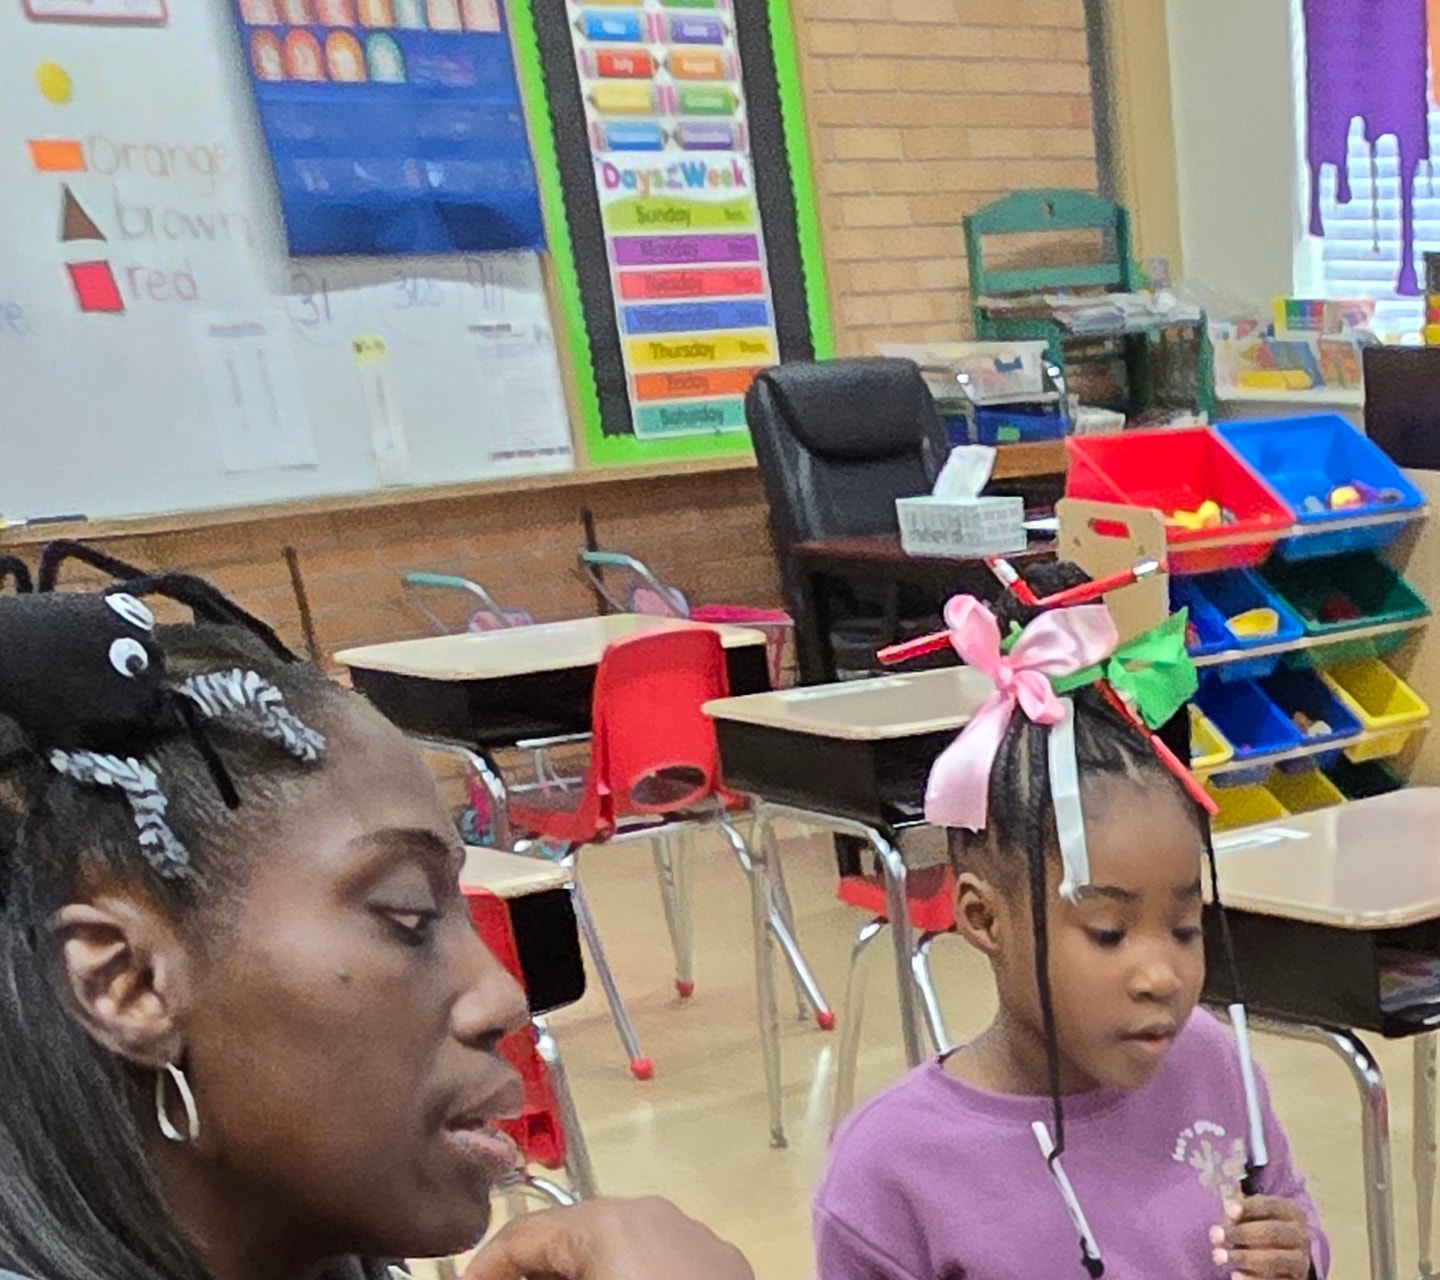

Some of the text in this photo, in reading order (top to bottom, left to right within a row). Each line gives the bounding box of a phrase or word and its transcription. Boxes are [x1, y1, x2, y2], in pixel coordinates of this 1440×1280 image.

[602, 161, 664, 199] Days
[681, 158, 747, 189] Week
[126, 256, 199, 302] red
[650, 341, 716, 361] Thursday
